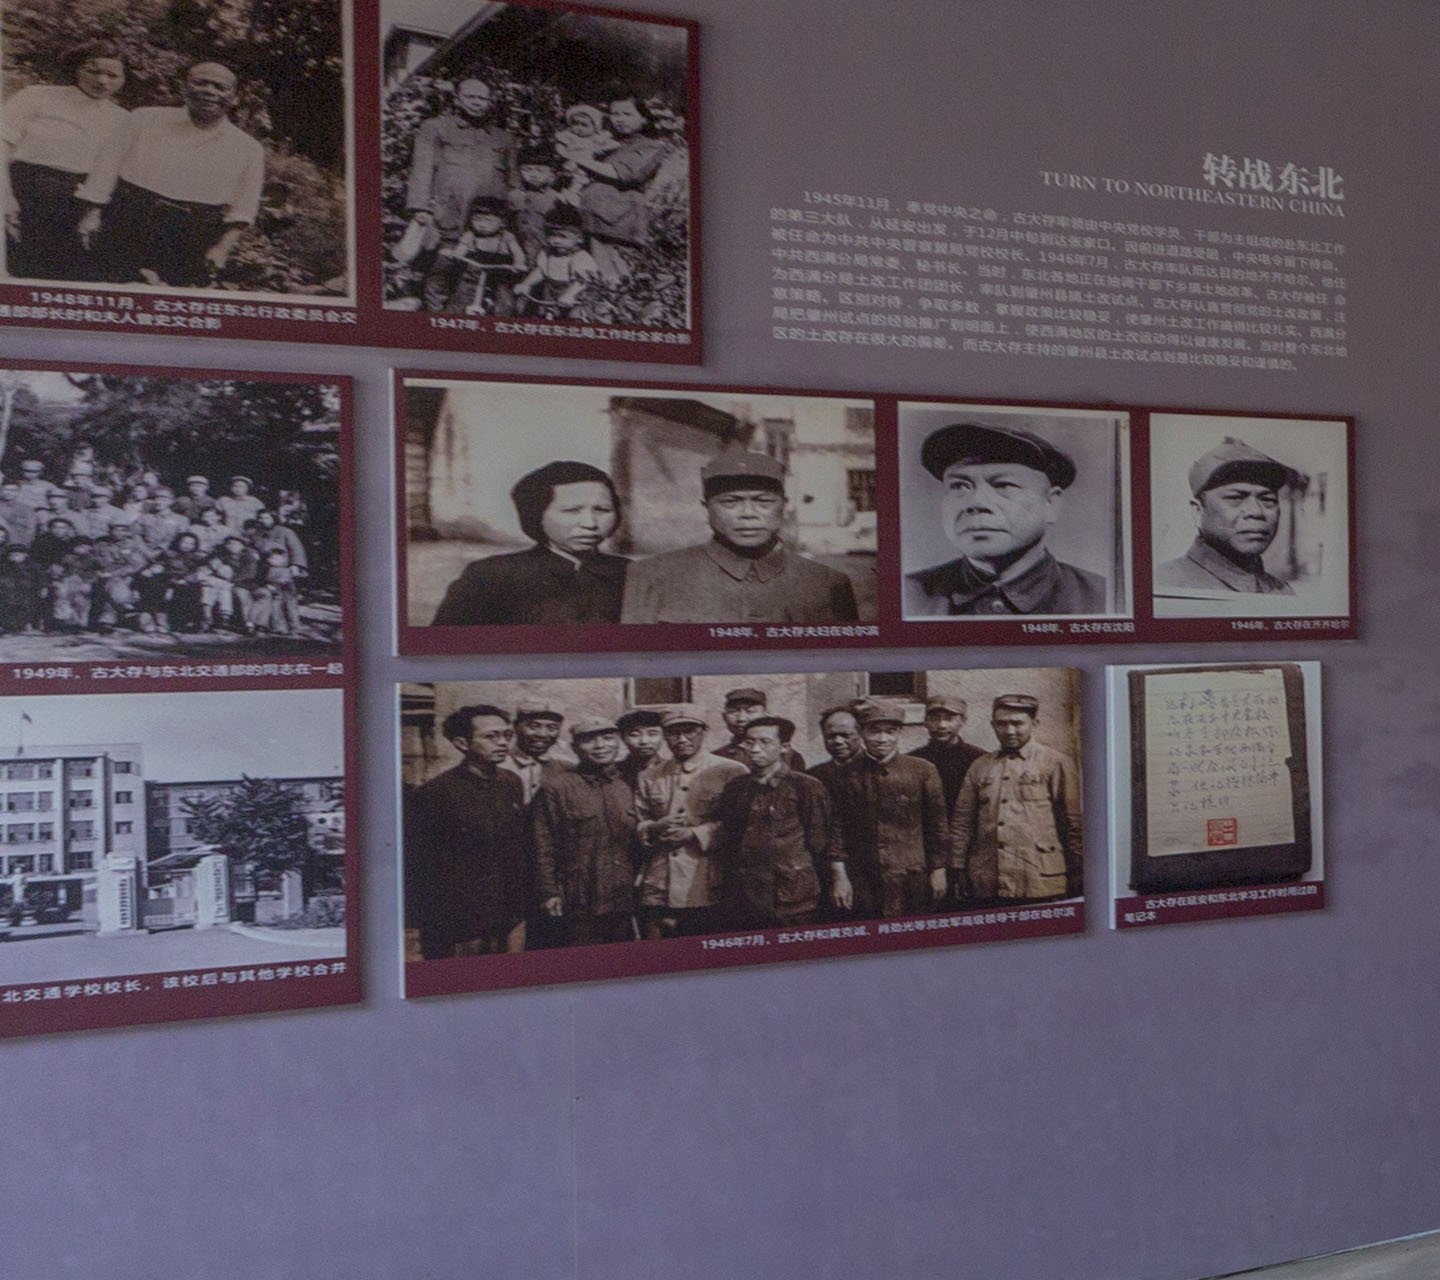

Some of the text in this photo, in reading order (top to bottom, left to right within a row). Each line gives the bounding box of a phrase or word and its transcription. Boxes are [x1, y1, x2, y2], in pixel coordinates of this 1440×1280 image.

[1040, 170, 1346, 217] TURN TO NORTHEASTERN CHINA
[1203, 152, 1345, 200] 转战东北
